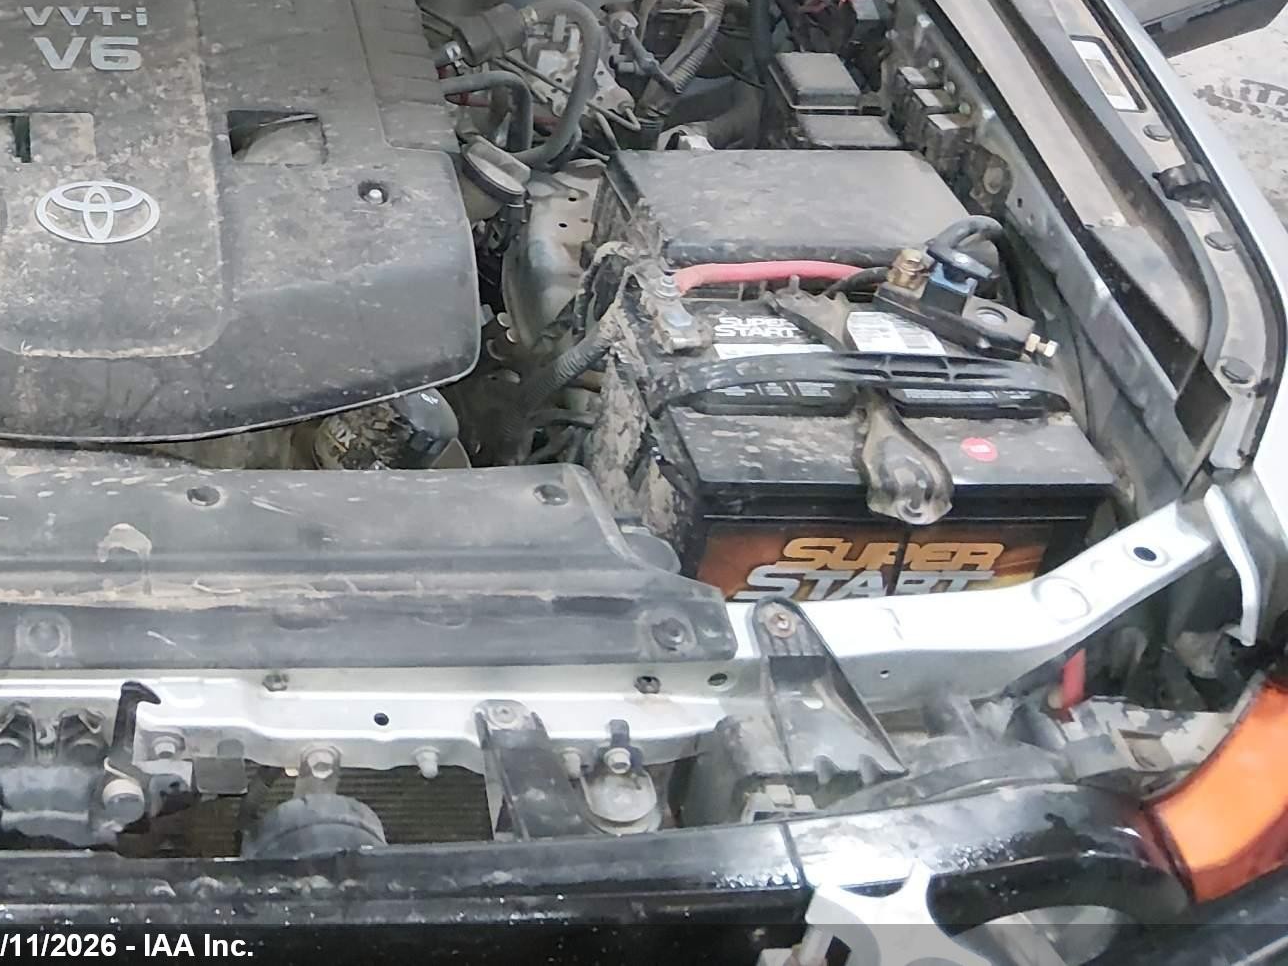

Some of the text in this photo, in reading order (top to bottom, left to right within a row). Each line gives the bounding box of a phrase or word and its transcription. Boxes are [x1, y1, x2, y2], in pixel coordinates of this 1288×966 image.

[23, 5, 148, 27] VVT-i
[33, 36, 142, 71] V6
[714, 324, 801, 338] START
[775, 537, 1005, 571] SUPER
[733, 564, 996, 602] START
